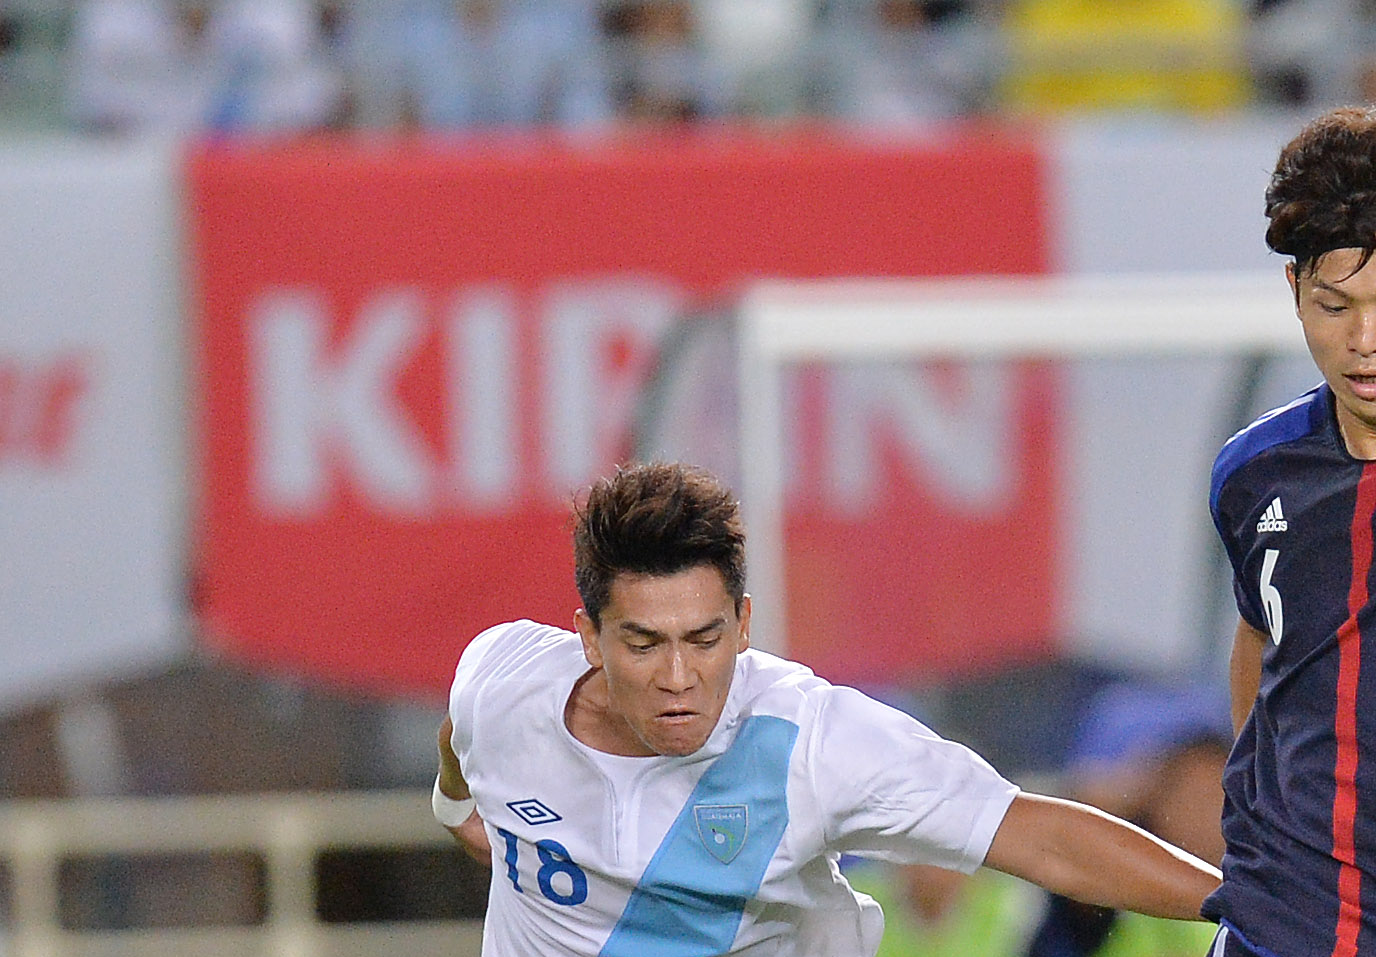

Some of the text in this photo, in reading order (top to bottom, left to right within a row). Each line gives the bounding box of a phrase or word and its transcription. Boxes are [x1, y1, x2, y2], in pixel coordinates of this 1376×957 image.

[1256, 518, 1288, 533] adidas
[1260, 549, 1284, 646] 6
[497, 827, 588, 906] 18
